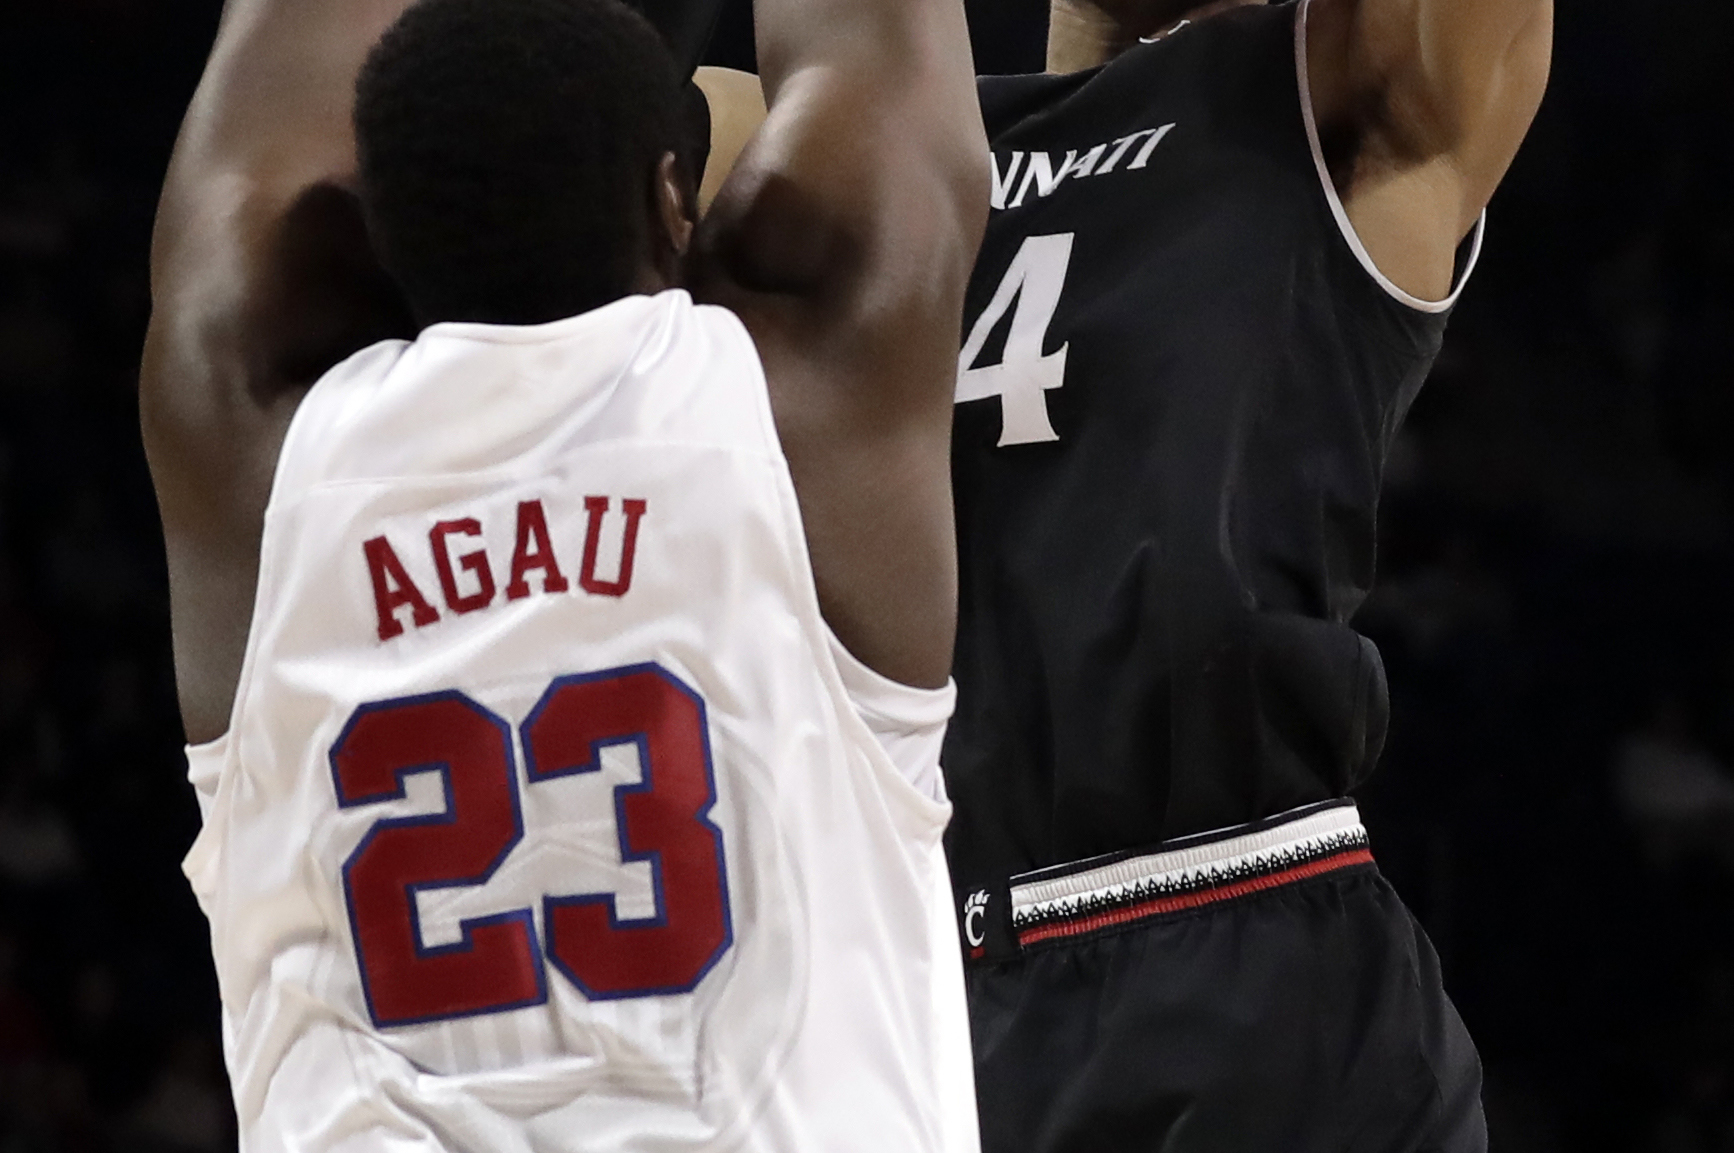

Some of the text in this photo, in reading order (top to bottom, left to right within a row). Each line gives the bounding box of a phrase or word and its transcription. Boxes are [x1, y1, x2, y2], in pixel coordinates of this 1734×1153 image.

[953, 232, 1075, 448] 4
[363, 495, 647, 642] AGAU
[329, 661, 734, 1029] 23
